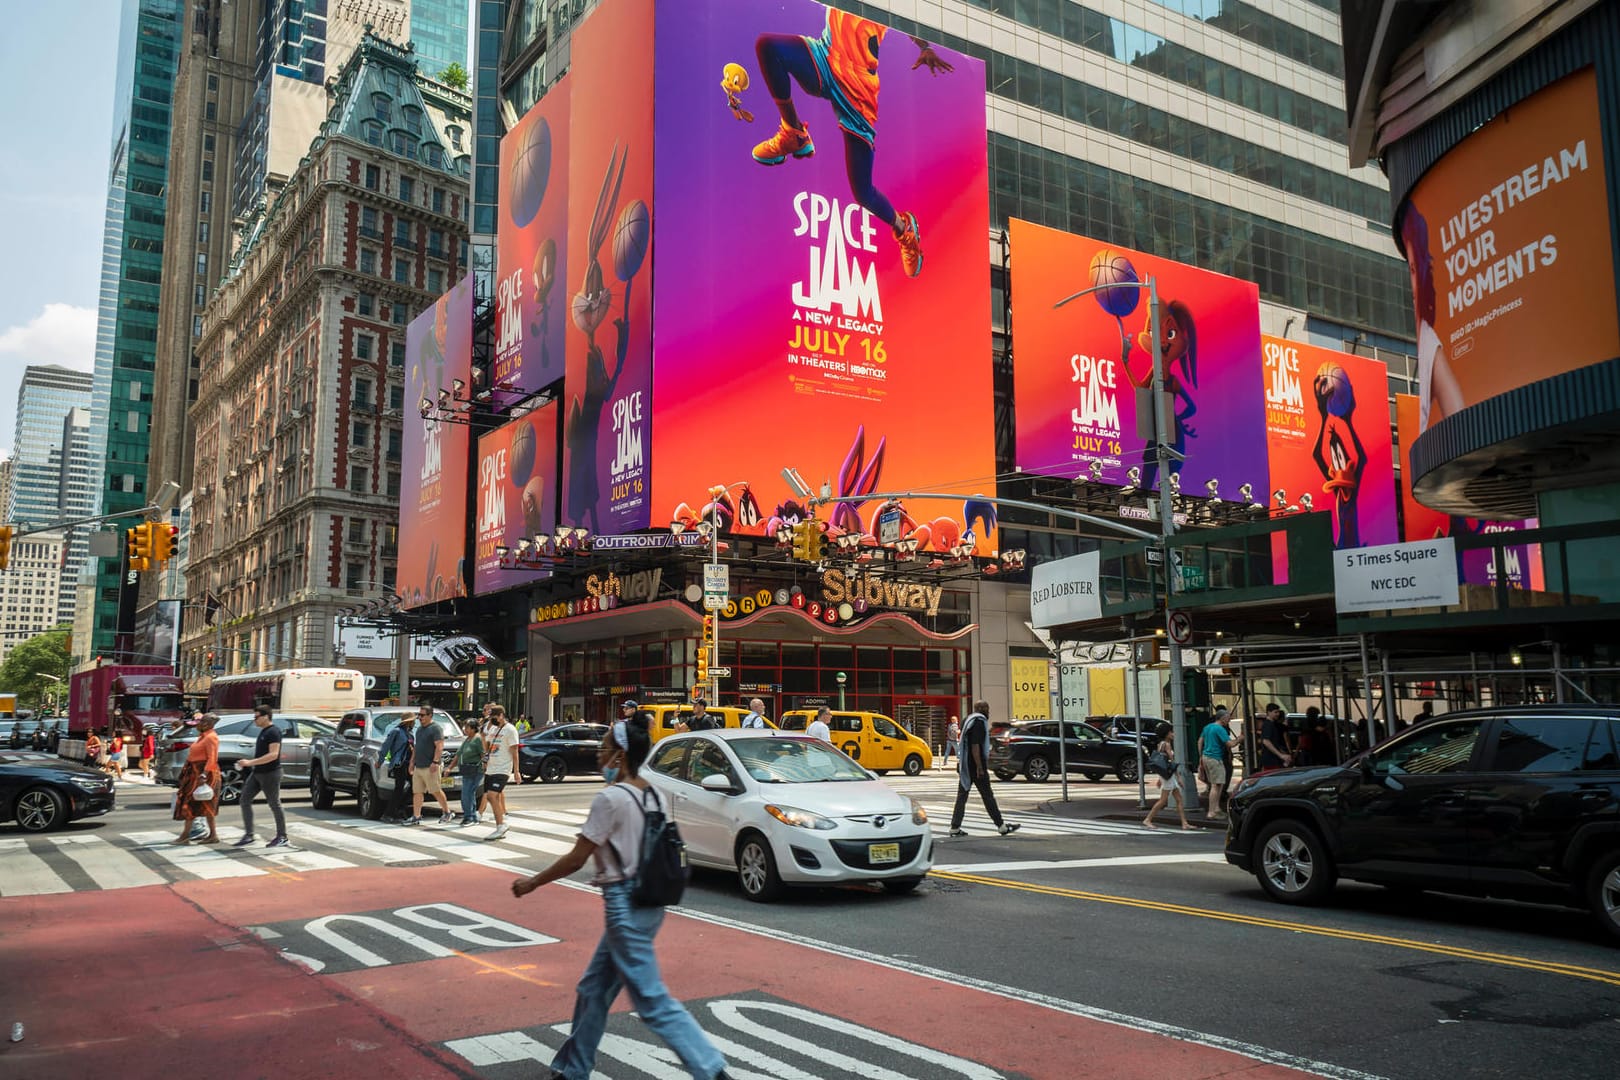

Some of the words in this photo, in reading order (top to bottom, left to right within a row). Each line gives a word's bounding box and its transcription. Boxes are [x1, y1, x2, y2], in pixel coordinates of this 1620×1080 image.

[1440, 139, 1588, 253] LIVESTREAM
[793, 191, 878, 253] SPACE
[1445, 229, 1497, 283] YOUR
[498, 267, 522, 312] SPACE
[791, 245, 883, 323] JAM
[1448, 234, 1558, 318] MOMENTS
[496, 303, 522, 355] JAM
[792, 309, 802, 320] A
[805, 311, 834, 326] NEW
[837, 317, 883, 335] LEGACY
[788, 325, 850, 356] JULY
[860, 338, 888, 363] 16
[1264, 342, 1300, 372] SPACE
[495, 360, 512, 380] JULY
[513, 353, 522, 368] 16
[788, 353, 799, 365] IN
[800, 355, 846, 372] THEATERS
[1071, 353, 1117, 389] SPACE
[1266, 370, 1304, 408] JAM
[612, 390, 642, 432] SPACE
[1071, 386, 1120, 430] JAM
[1267, 411, 1290, 425] JULY
[1295, 415, 1306, 428] 16
[1285, 406, 1304, 415] LEGACY
[1072, 435, 1102, 452] JULY
[1107, 440, 1121, 455] 16
[1079, 426, 1094, 434] NEW
[1095, 429, 1120, 438] LEGACY
[421, 437, 441, 481] JAM
[611, 427, 643, 476] JAM
[481, 448, 506, 488] SPACE
[615, 474, 625, 482] NEW
[626, 467, 643, 480] LEGACY
[611, 481, 631, 501] JULY
[633, 478, 643, 494] 16
[480, 484, 506, 533] JAM
[479, 541, 495, 560] JULY
[596, 535, 664, 547] OUTFRONT
[1347, 555, 1354, 567] 5
[1356, 553, 1392, 566] Times
[1394, 548, 1437, 564] Square
[1486, 546, 1521, 574] JM
[822, 568, 943, 616] Subway
[1033, 588, 1049, 605] RED
[1051, 581, 1093, 598] LOBSTER
[1371, 578, 1393, 590] NYC
[1394, 576, 1416, 589] EDC
[727, 602, 735, 614] Q
[744, 599, 752, 610] R
[760, 593, 769, 604] W
[779, 591, 786, 602] S
[797, 595, 802, 606] 1
[812, 604, 818, 615] 2
[828, 609, 835, 620] 3
[859, 599, 865, 609] 7
[1062, 666, 1084, 674] OFT
[1015, 682, 1045, 692] LOVE
